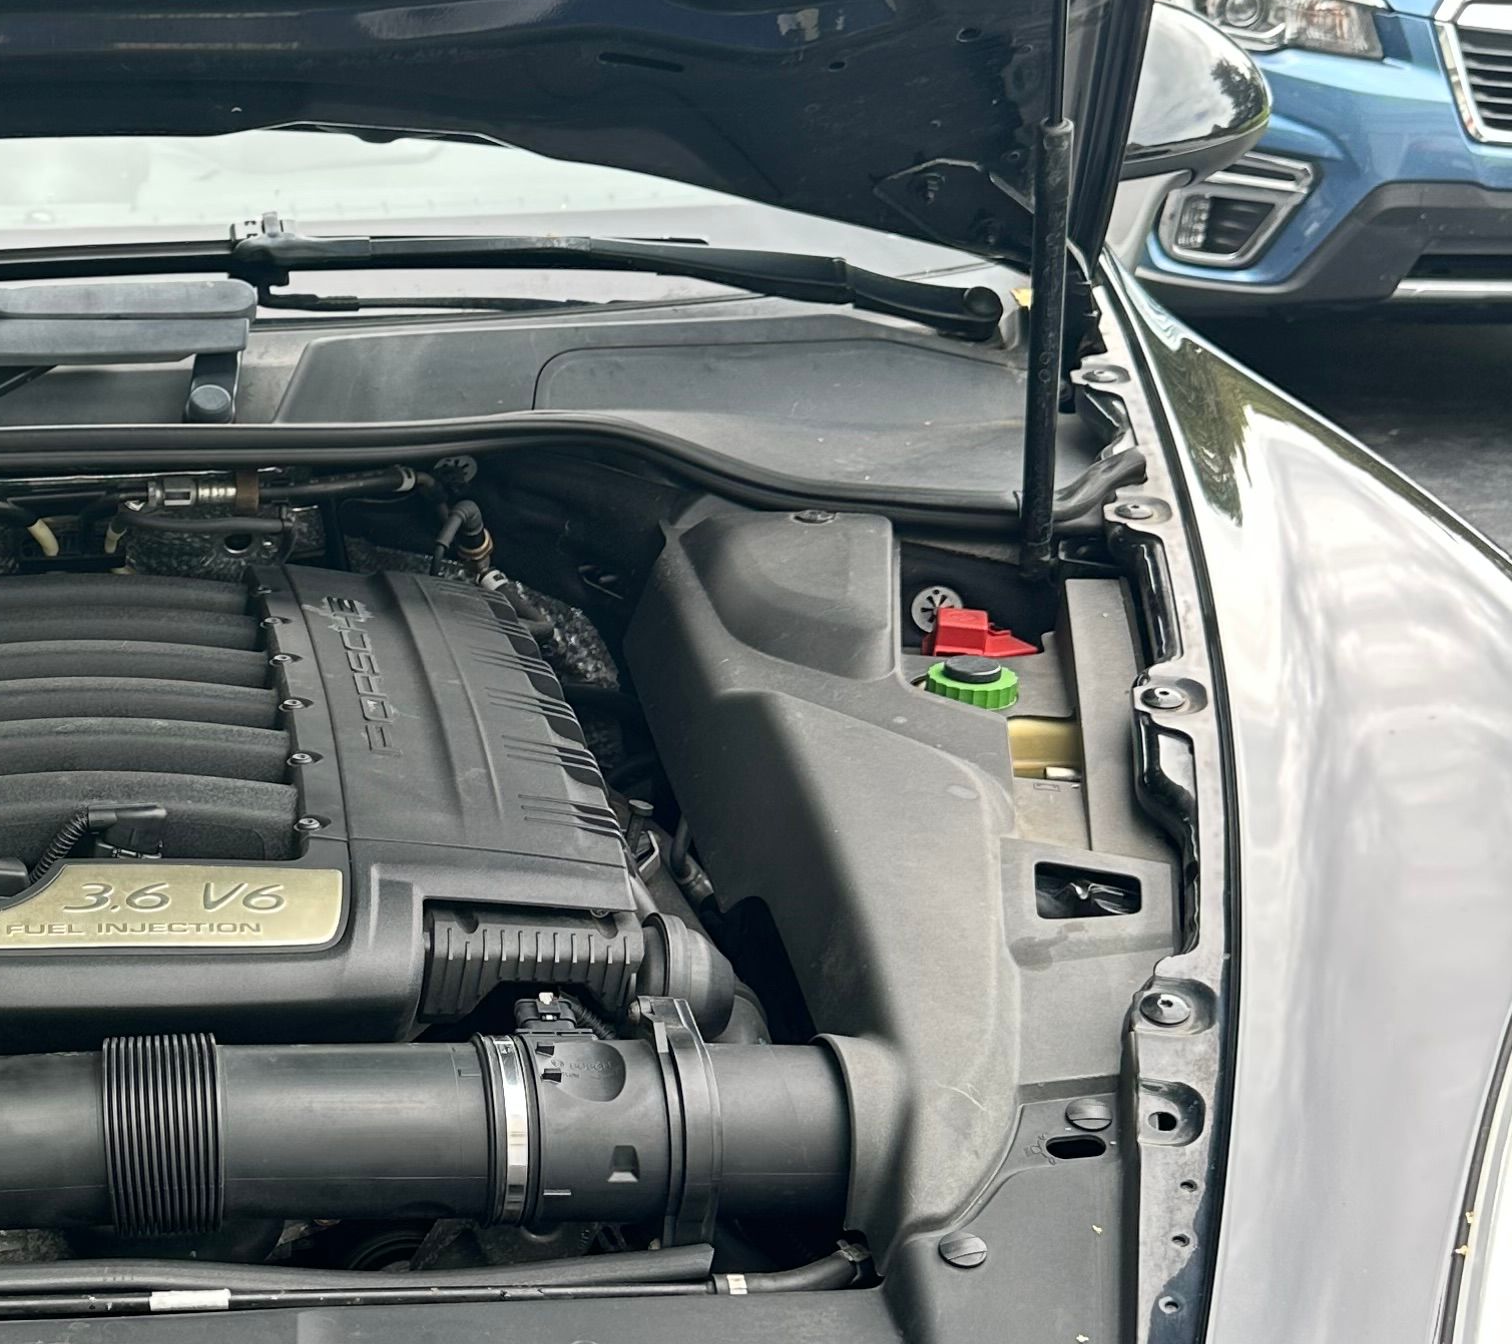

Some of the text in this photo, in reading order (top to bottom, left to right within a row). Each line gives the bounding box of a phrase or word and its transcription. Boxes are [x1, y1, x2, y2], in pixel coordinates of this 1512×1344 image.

[63, 881, 287, 913] 3.6 V6
[5, 924, 89, 938] FUEL
[96, 921, 262, 936] INJECTION
